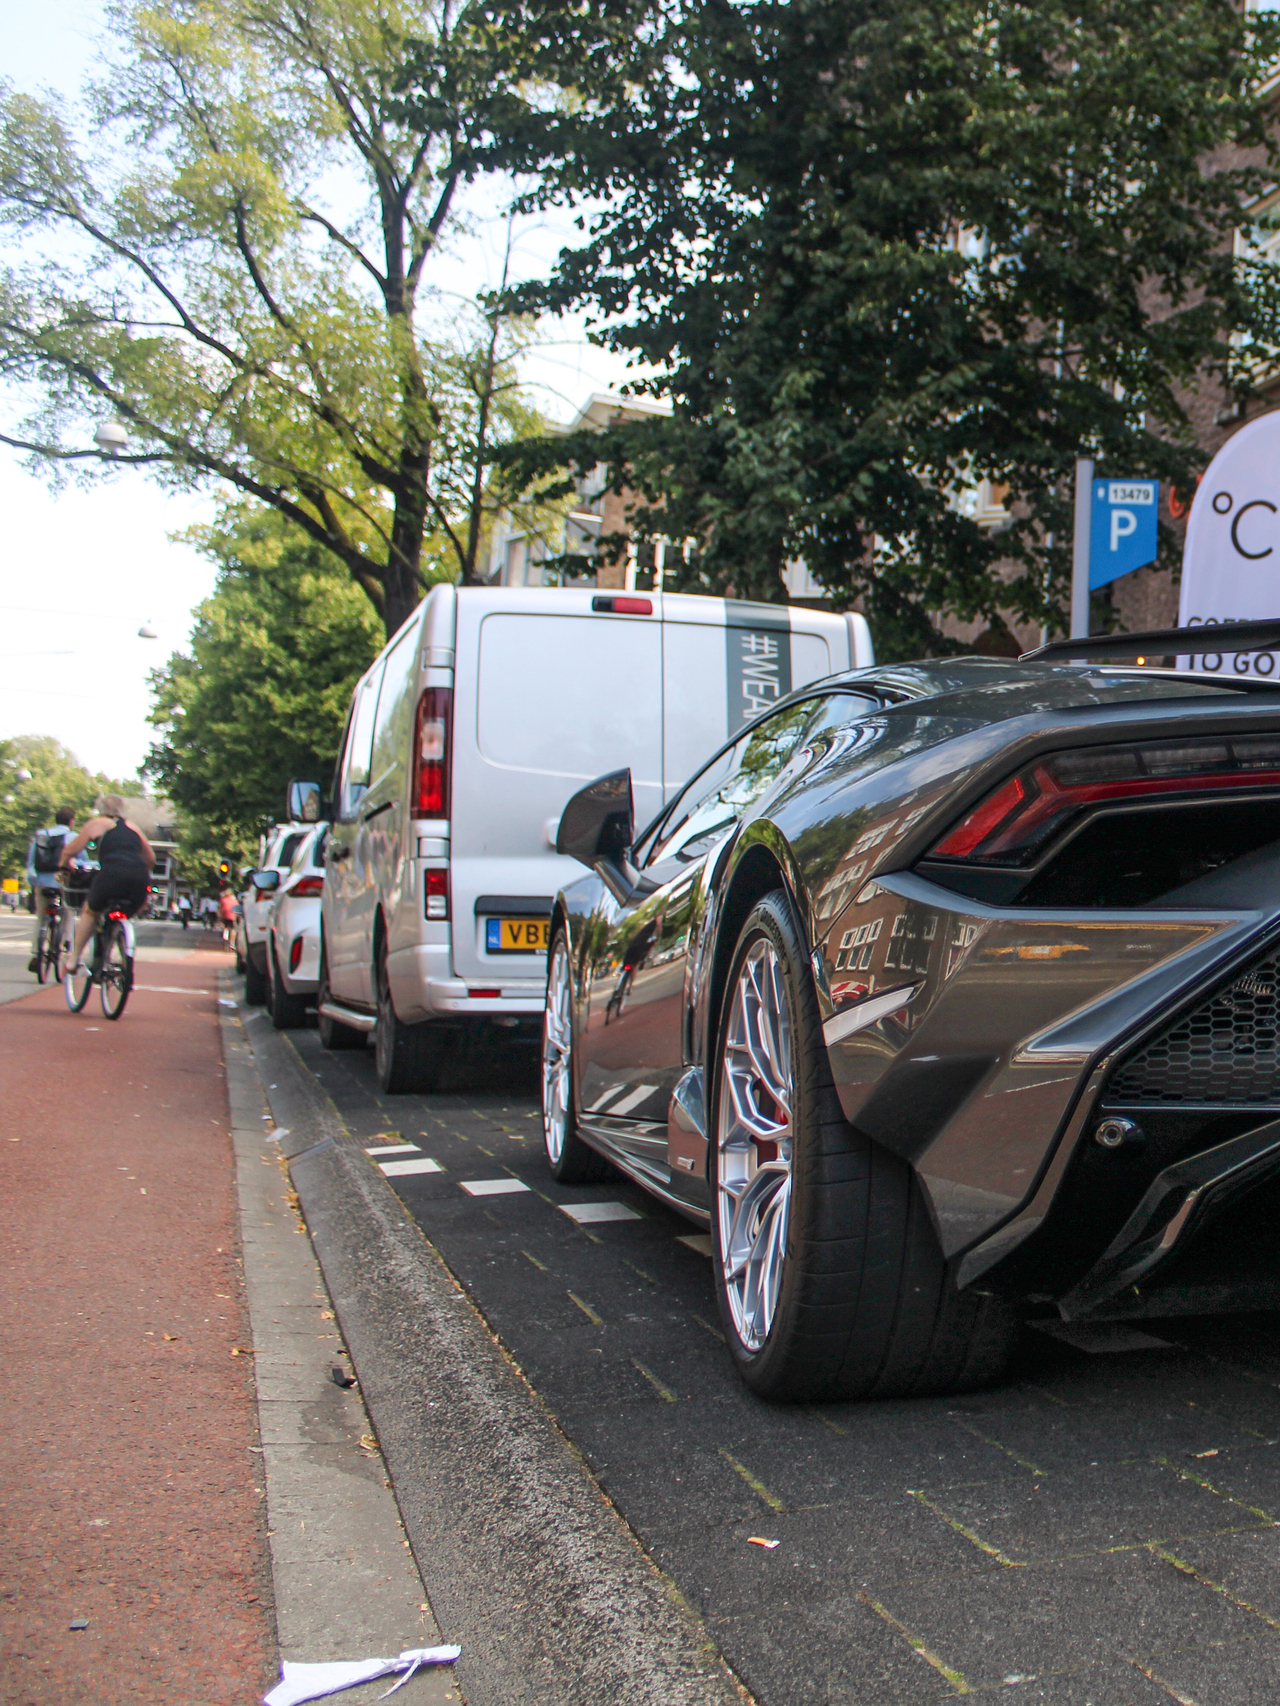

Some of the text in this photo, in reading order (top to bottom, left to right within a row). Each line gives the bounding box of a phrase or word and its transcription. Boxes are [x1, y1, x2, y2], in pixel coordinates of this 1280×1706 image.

[1112, 488, 1150, 501] 13479
[1110, 509, 1137, 551] P
[1233, 652, 1275, 676] GO
